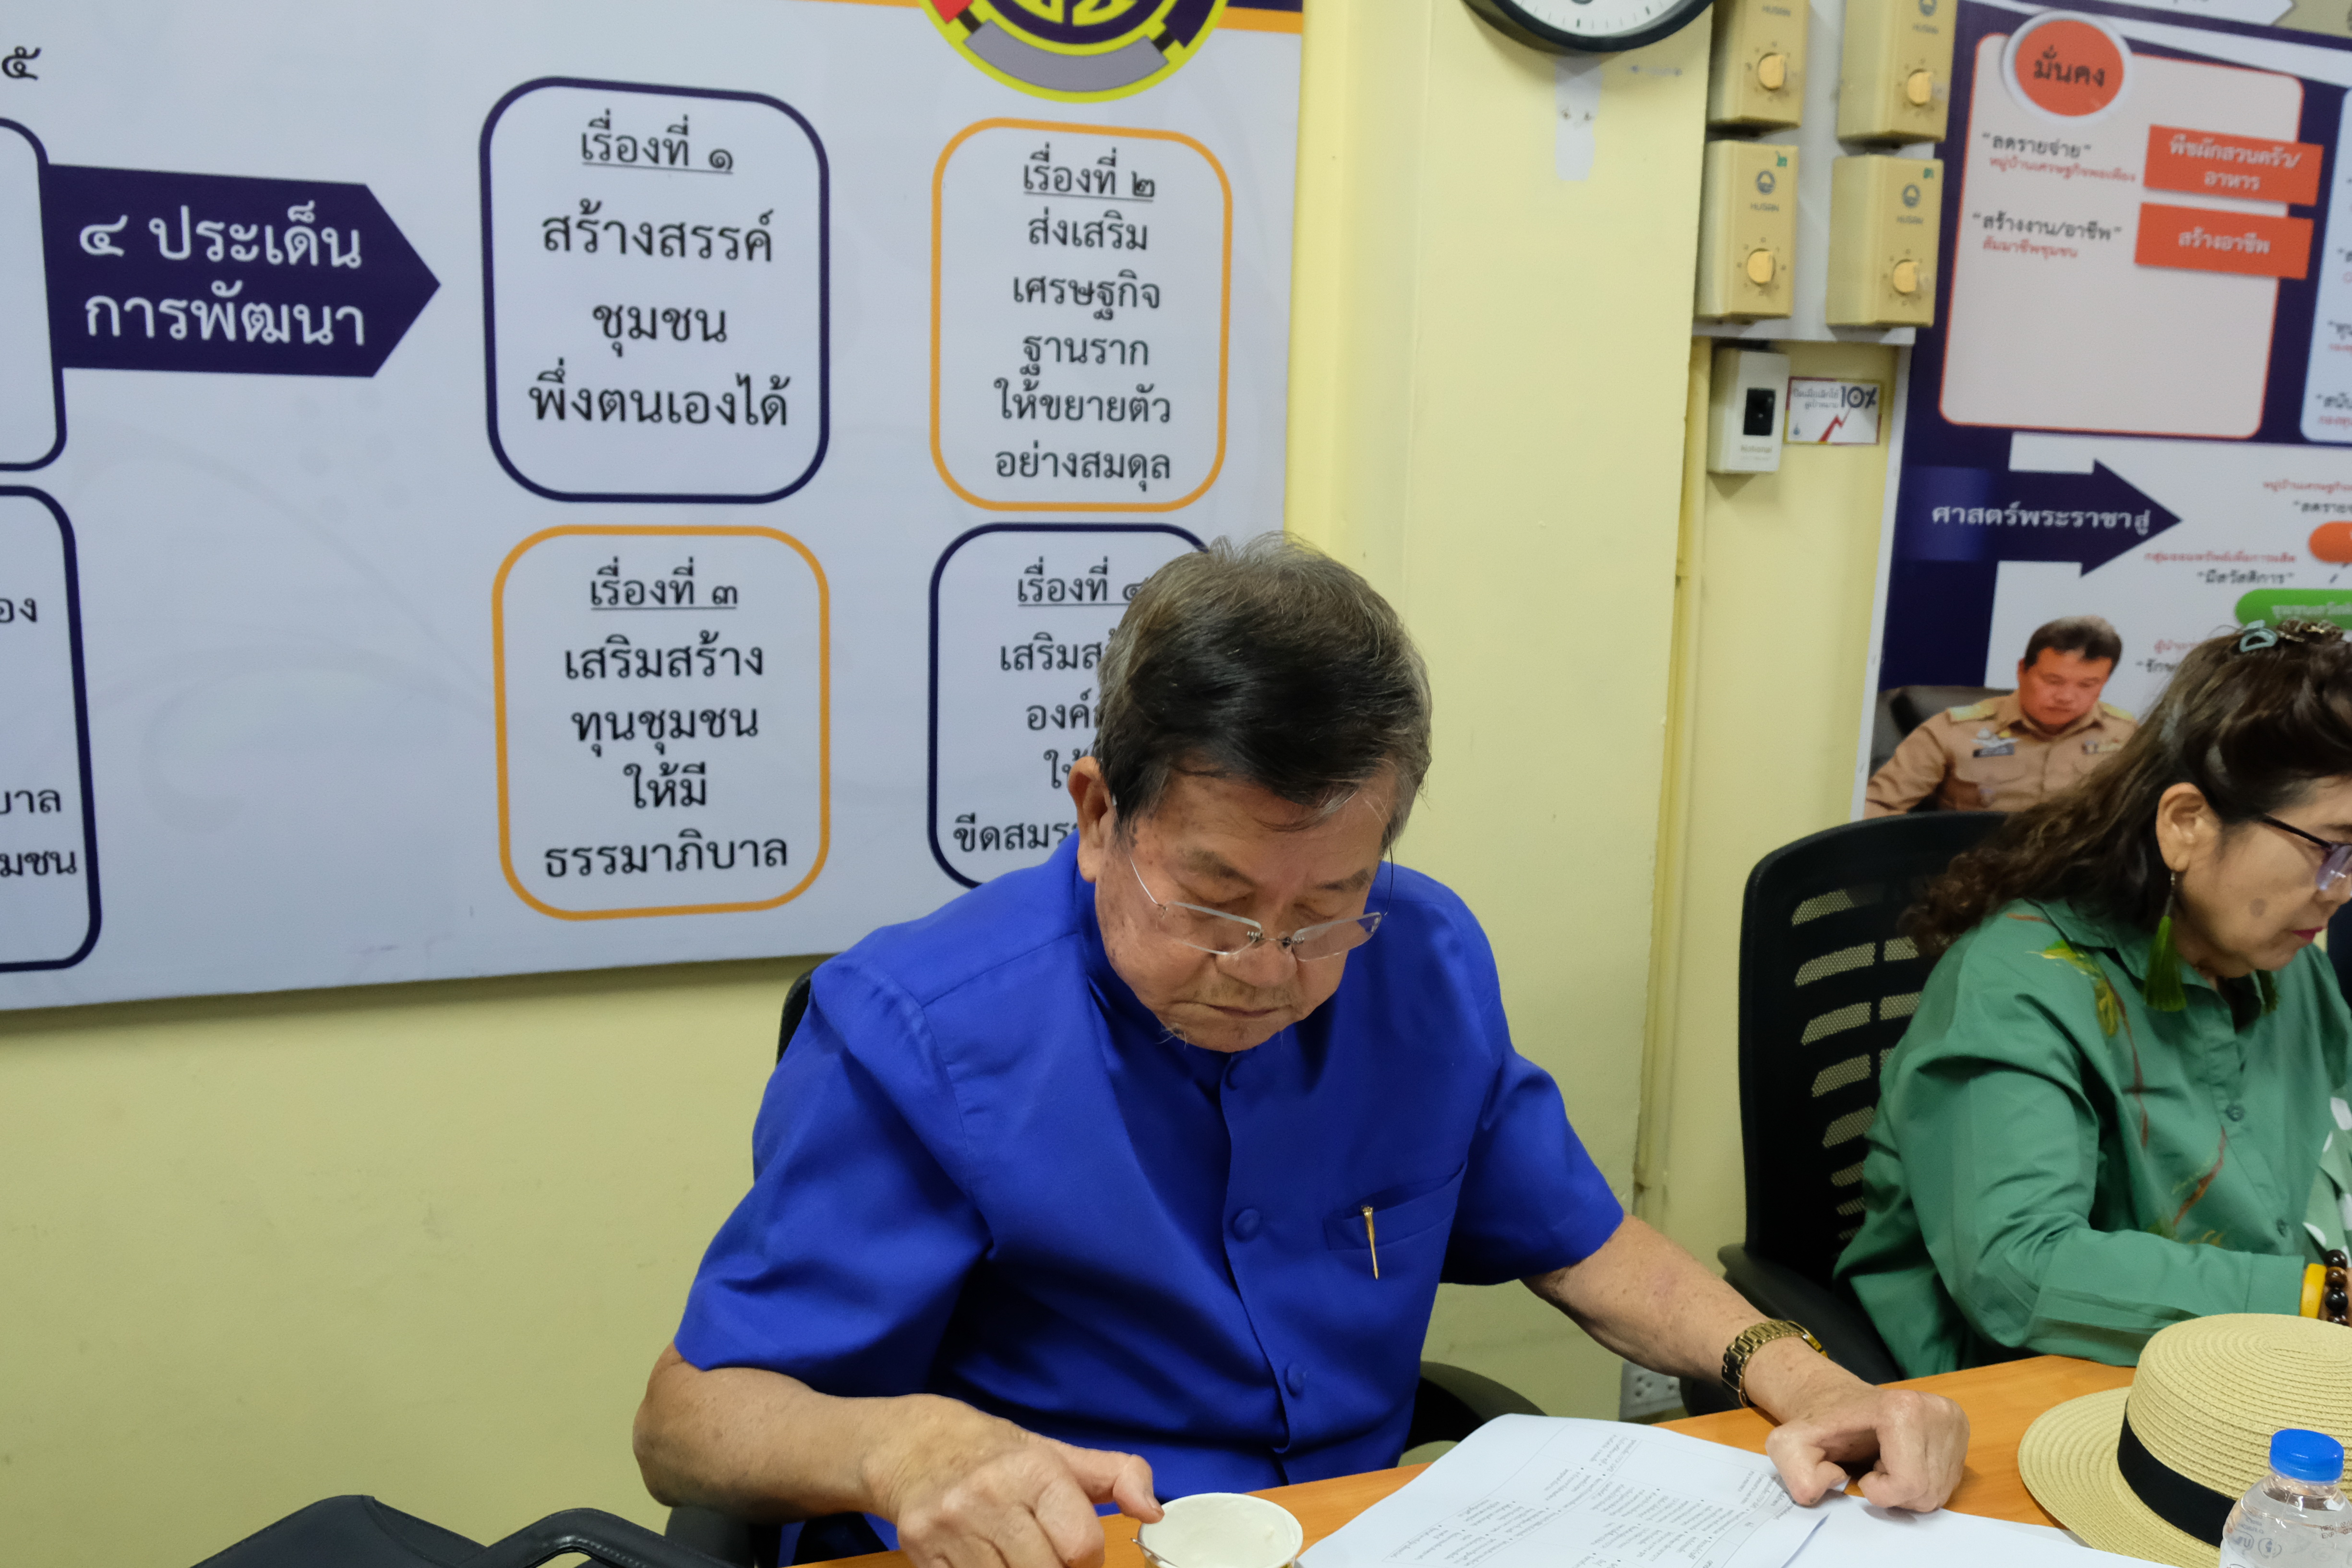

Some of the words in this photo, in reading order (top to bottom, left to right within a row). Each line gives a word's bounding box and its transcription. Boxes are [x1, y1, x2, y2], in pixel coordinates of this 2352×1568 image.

[1, 46, 41, 80] ๕
[2033, 45, 2105, 88] มั่นคง
[582, 108, 689, 166] เรื่องที่
[708, 148, 733, 168] ๑
[1024, 143, 1117, 194] เรื่องที่
[1131, 171, 1156, 197] ๒
[80, 214, 128, 257] ๔
[148, 200, 362, 269] ประเด็น
[542, 198, 773, 262] สร้างสรรค์
[1029, 207, 1147, 251] ส่งเสริม
[85, 280, 364, 346] การพัฒนา
[1013, 269, 1160, 321] เศรษฐกิจ
[593, 305, 727, 358] ชุมชน
[1020, 336, 1149, 376] ฐานราก
[528, 357, 790, 426] พึ่งตนเองได้
[994, 378, 1170, 423] ให้ขยายตัว
[1841, 386, 1878, 408] 10%
[996, 440, 1170, 492] อย่างสมดุล
[1932, 501, 2150, 535] ศาสตร์พระราชาสู่
[590, 556, 695, 606] เรื่องที่
[711, 586, 738, 606] ๓
[1017, 556, 1108, 602] เรื่องที่
[565, 630, 763, 680] เสริมสร้าง
[571, 708, 758, 757] ทุนชุมชน
[1026, 688, 1097, 730] องค์
[624, 762, 706, 809] ให้มี
[544, 828, 787, 878] ธรรมาภิบาล
[953, 813, 1078, 853] ขีดสมร
